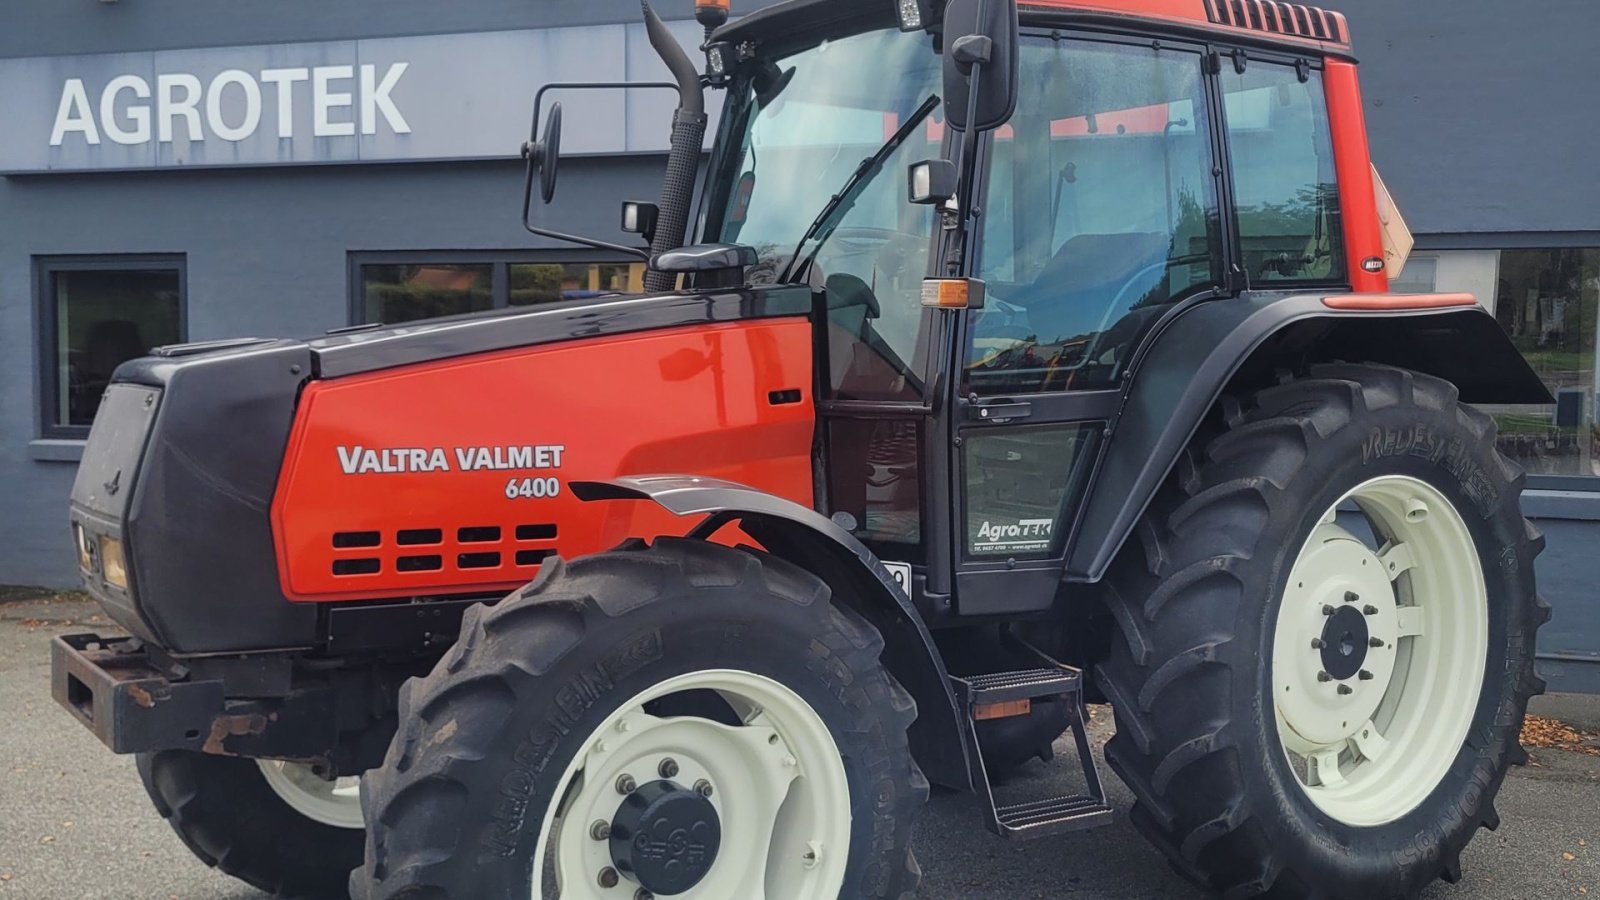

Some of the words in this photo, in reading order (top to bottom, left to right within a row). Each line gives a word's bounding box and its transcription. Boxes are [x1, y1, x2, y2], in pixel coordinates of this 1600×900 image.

[49, 62, 412, 146] AGROTEK
[336, 445, 450, 474] VALTRA
[455, 445, 565, 471] VALMET
[505, 477, 560, 499] 6400
